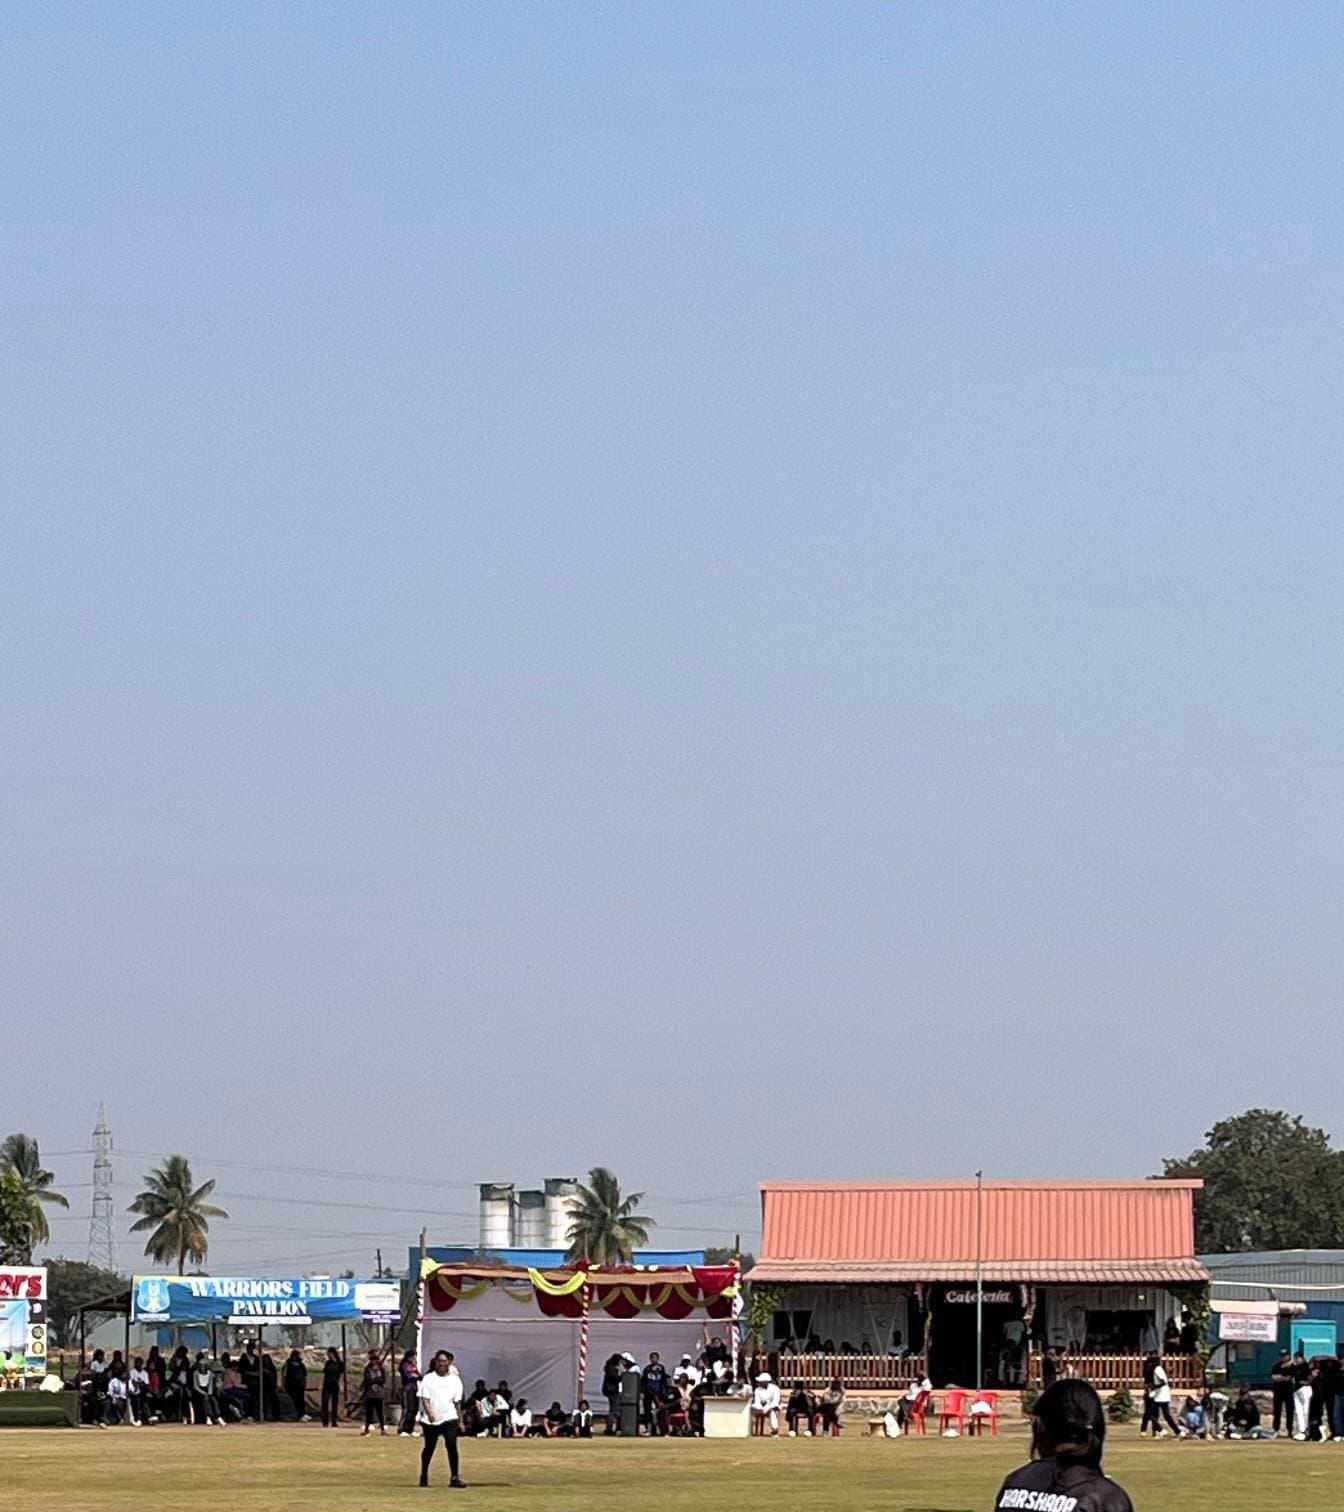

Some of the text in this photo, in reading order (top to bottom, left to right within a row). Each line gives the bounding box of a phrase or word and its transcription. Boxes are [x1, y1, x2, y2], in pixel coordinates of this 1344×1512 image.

[190, 1279, 293, 1298] WARRIORS
[299, 1280, 350, 1298] FIELD
[233, 1300, 307, 1316] PAVILION
